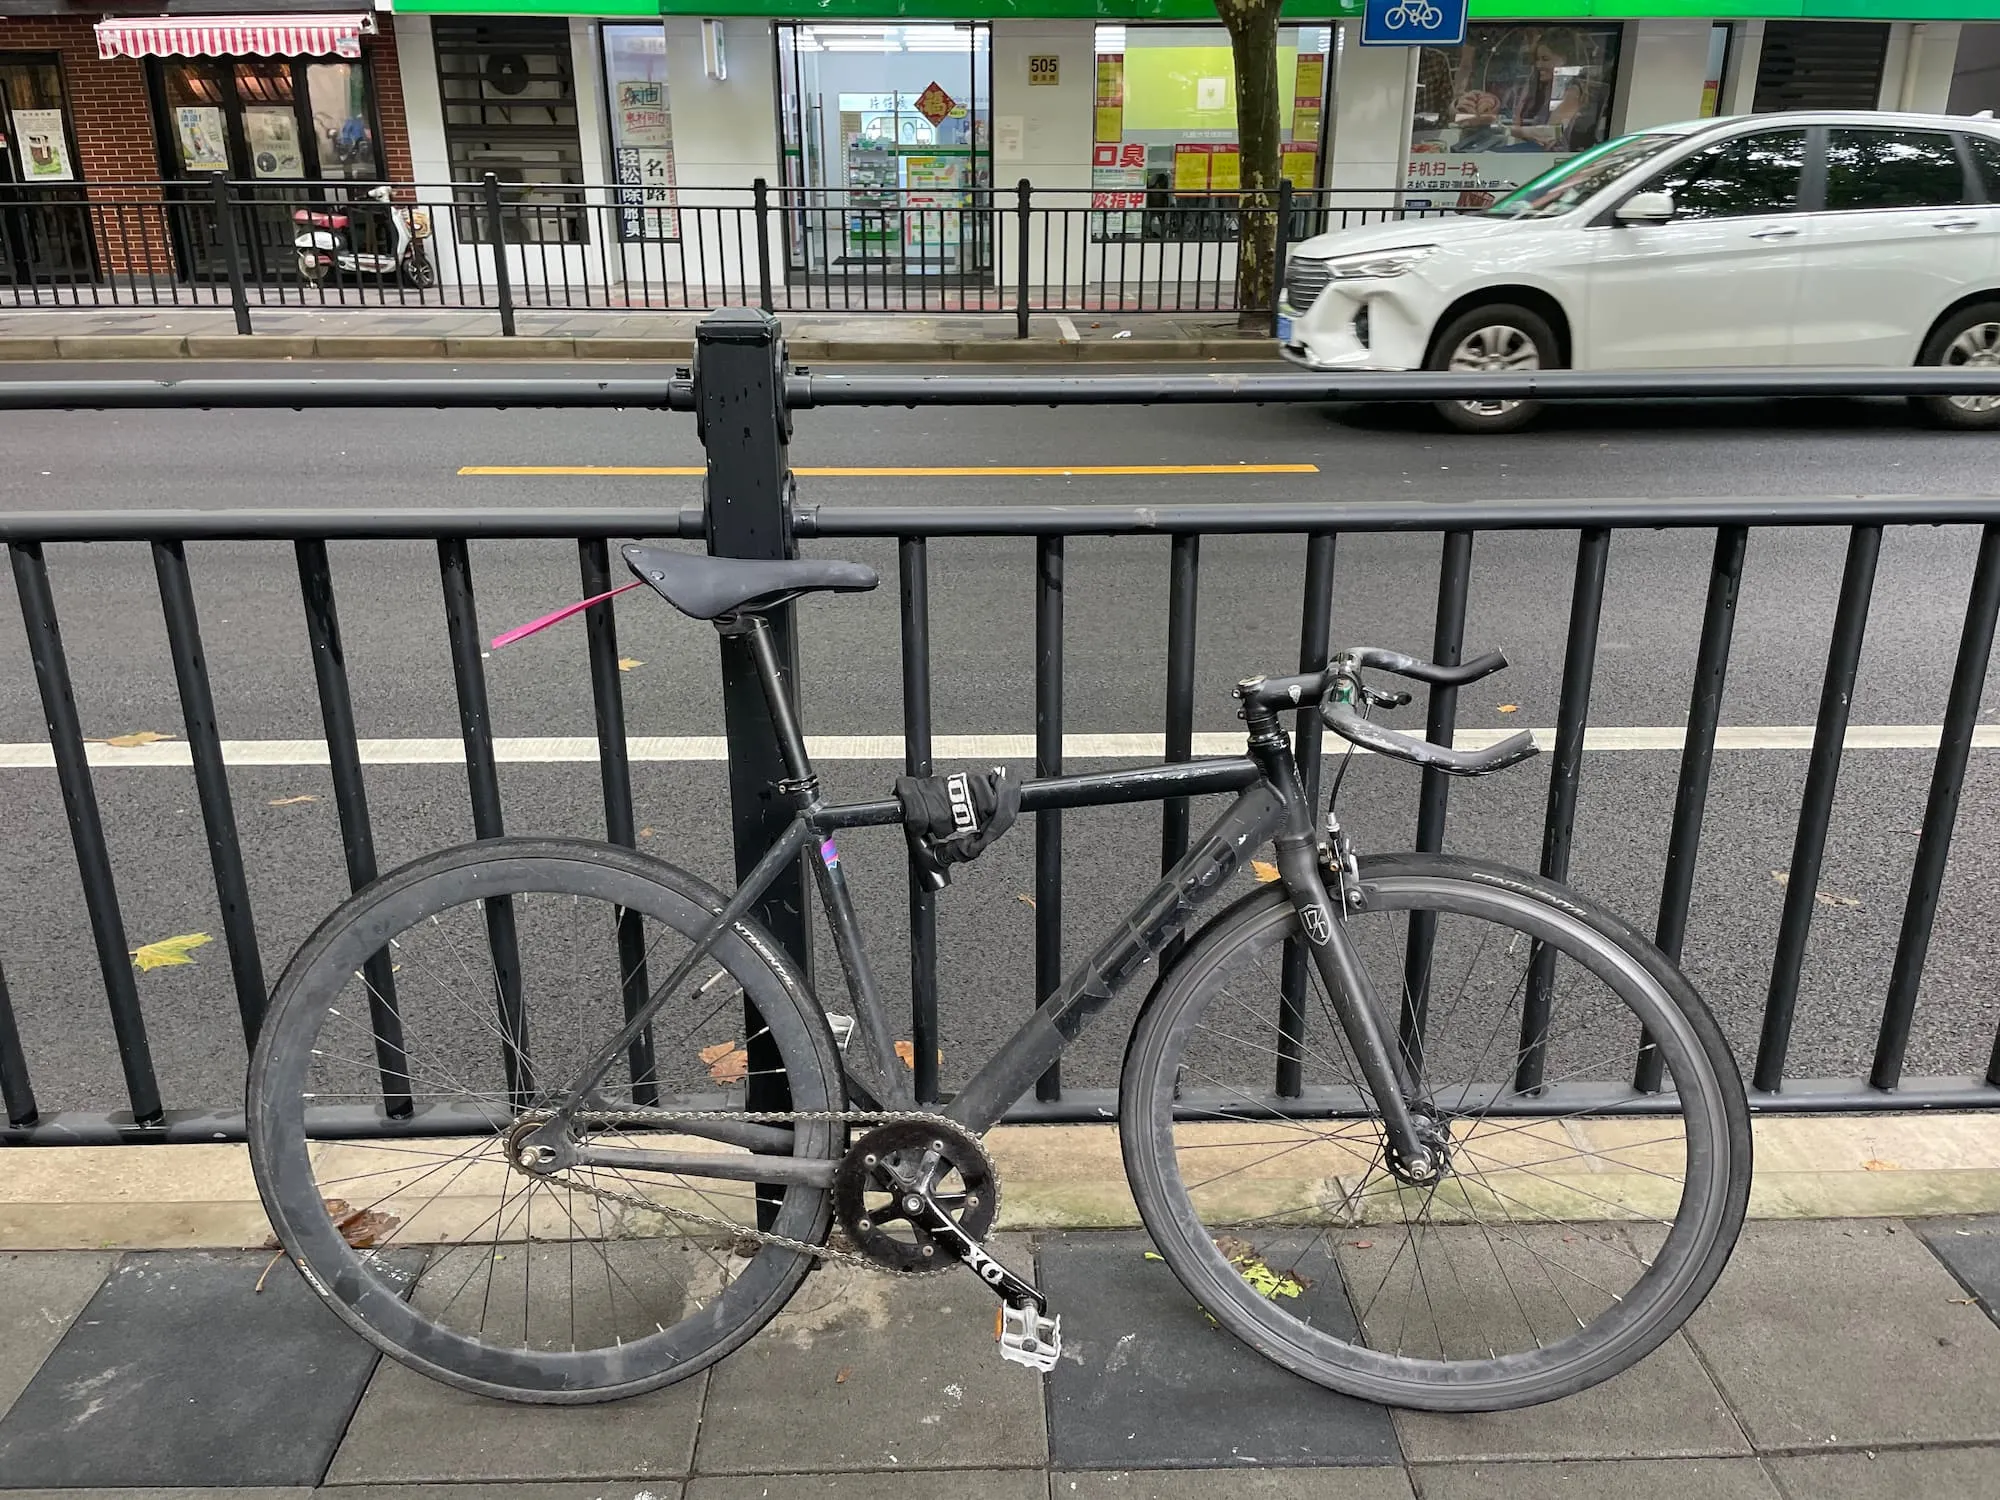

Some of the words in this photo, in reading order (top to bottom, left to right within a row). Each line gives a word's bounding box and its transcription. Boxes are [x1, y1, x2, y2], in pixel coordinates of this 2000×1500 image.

[1031, 59, 1057, 73] 505
[1094, 144, 1145, 168] 口臭
[1408, 162, 1476, 177] 手机扫一扫
[713, 907, 794, 990] CNTINENTAL
